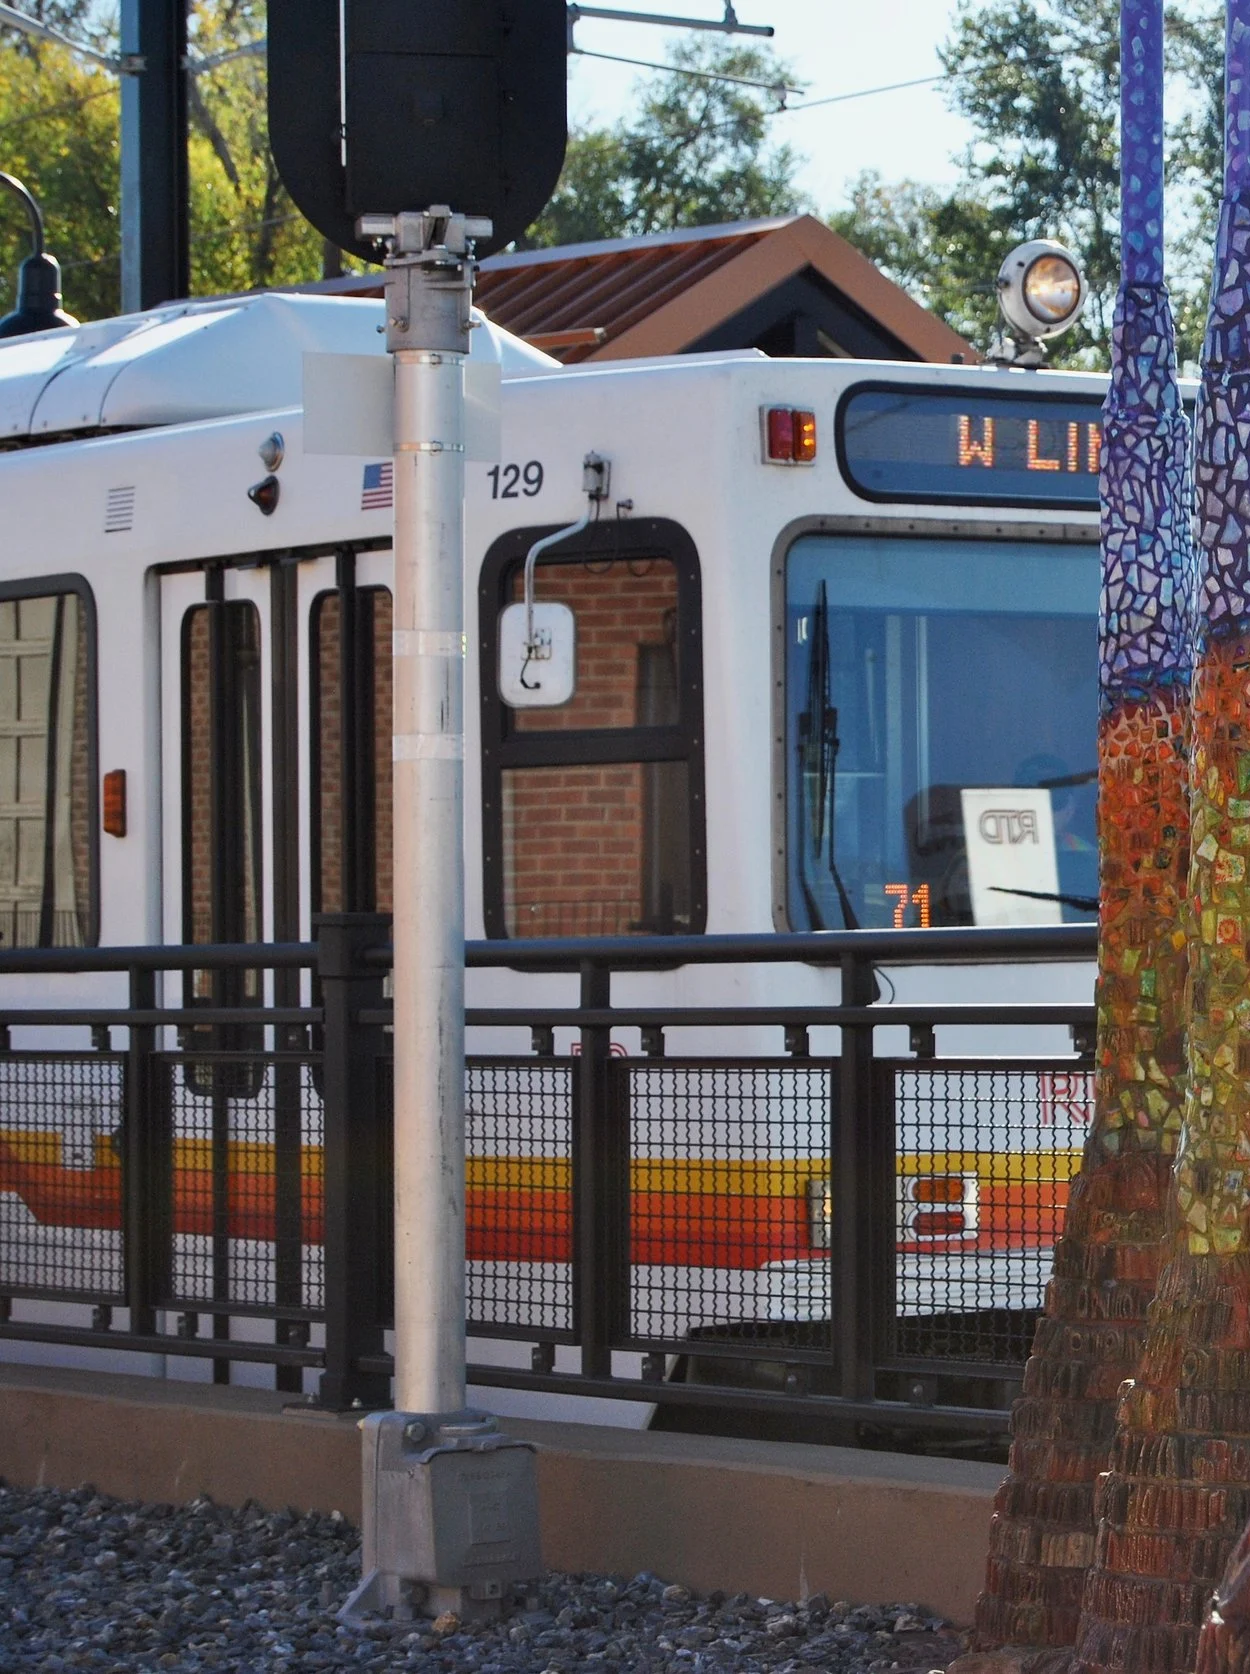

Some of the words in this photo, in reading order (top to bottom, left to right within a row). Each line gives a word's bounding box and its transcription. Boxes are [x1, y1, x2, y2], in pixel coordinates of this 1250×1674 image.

[958, 415, 995, 466] W
[487, 460, 544, 500] 129
[884, 883, 931, 928] 71
